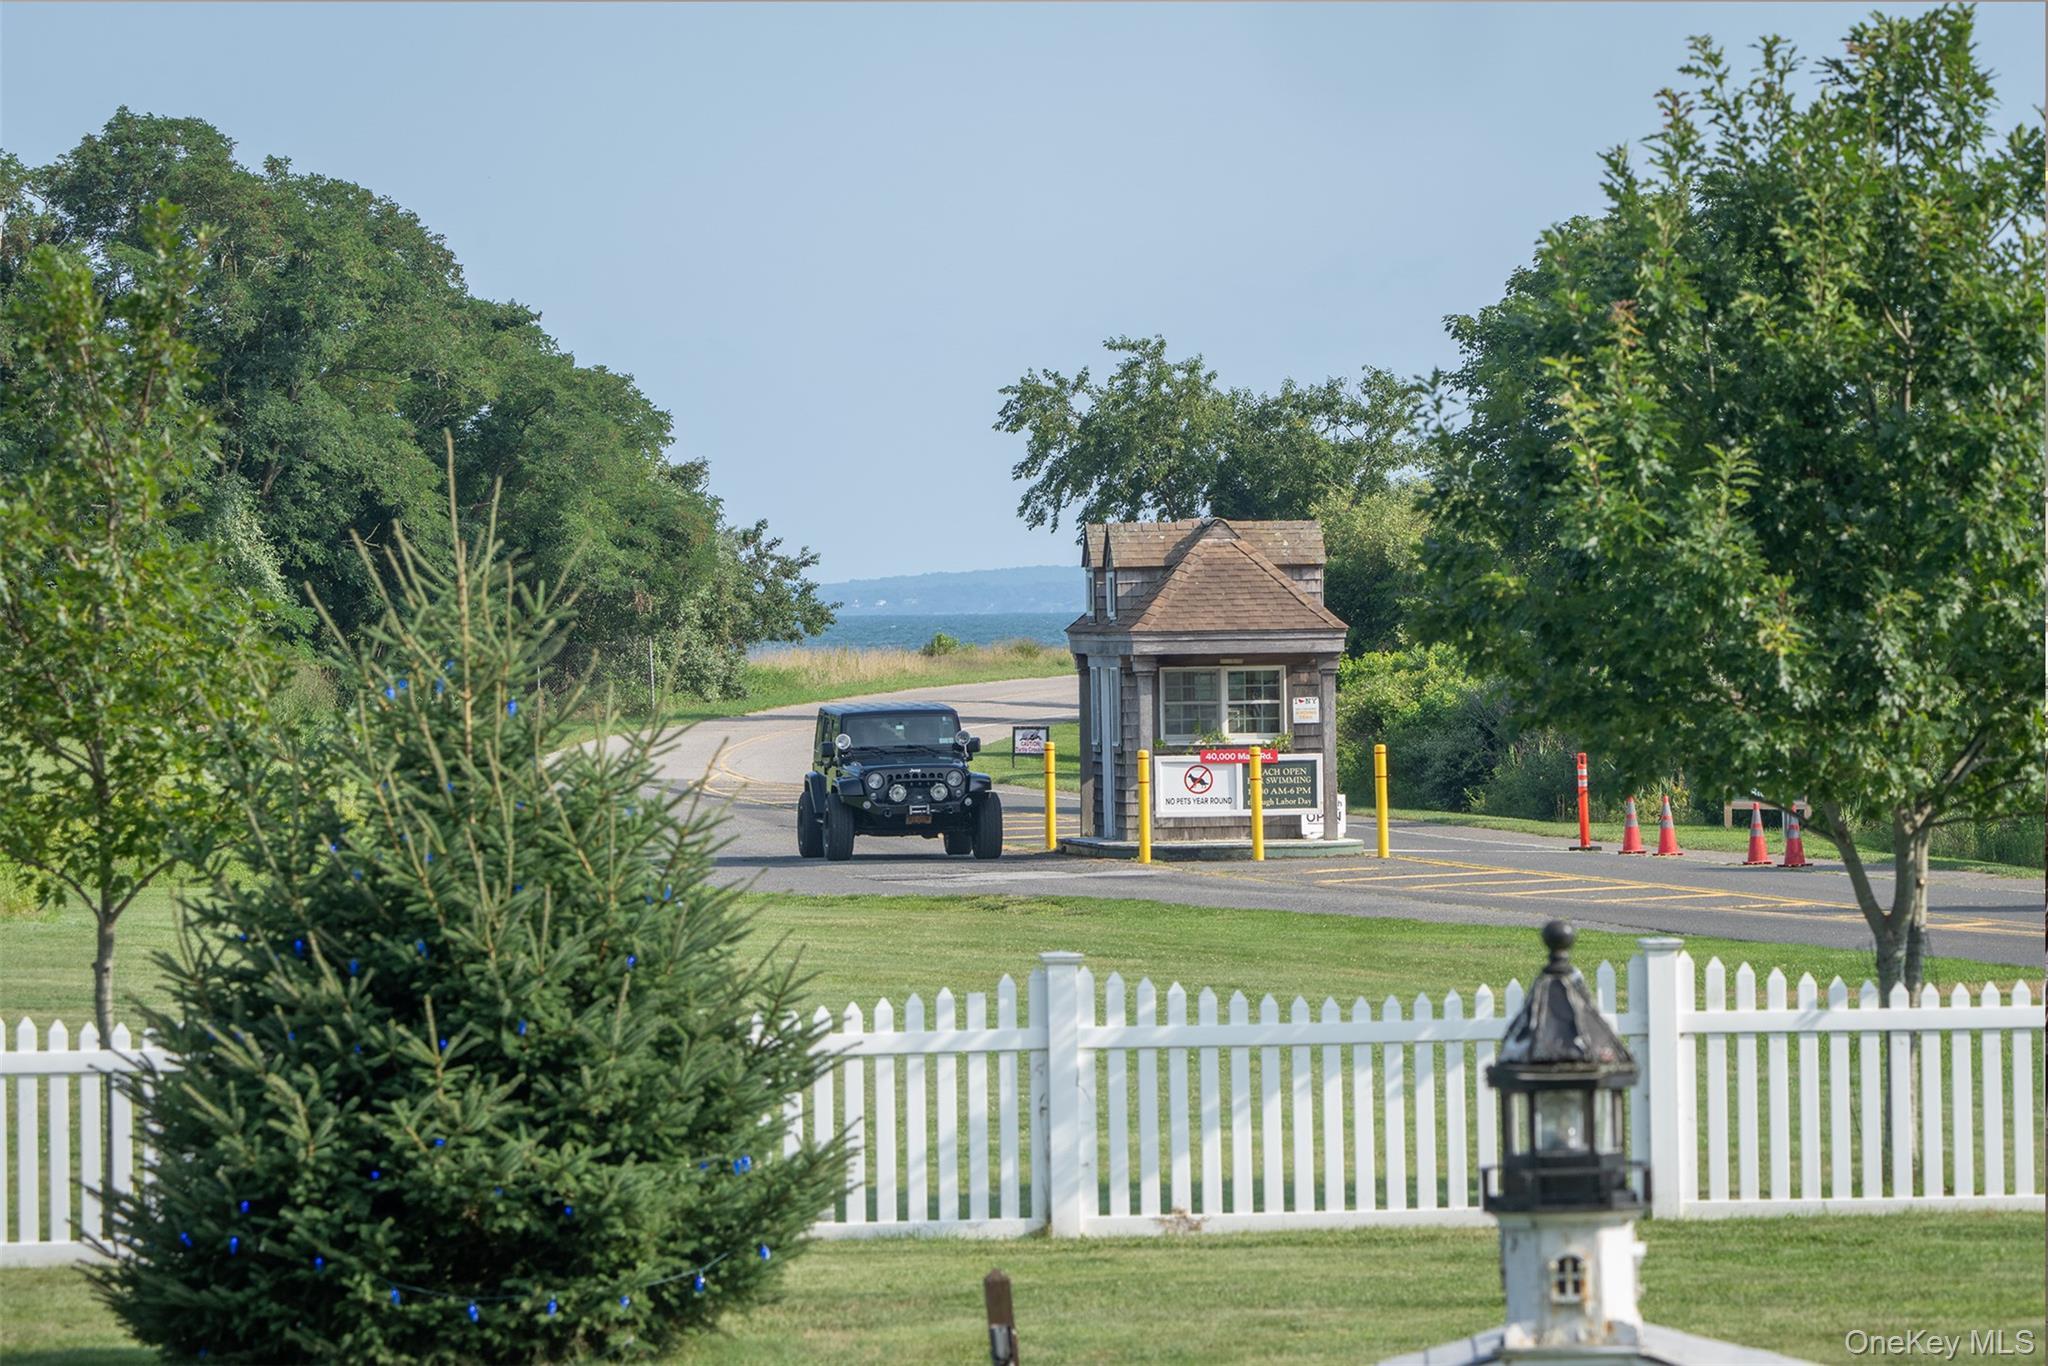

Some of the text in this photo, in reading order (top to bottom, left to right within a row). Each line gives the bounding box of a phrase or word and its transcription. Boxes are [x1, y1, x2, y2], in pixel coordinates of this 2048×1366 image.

[1205, 752, 1236, 762] 40,000
[1261, 752, 1274, 761] Rd.
[1282, 767, 1307, 776] OPEN
[1266, 776, 1312, 784] SWIMMING
[1270, 787, 1295, 795] AM-6
[1296, 787, 1311, 795] PM
[1165, 796, 1233, 805] NO PETS YEAR ROUND
[1297, 797, 1312, 806] Day
